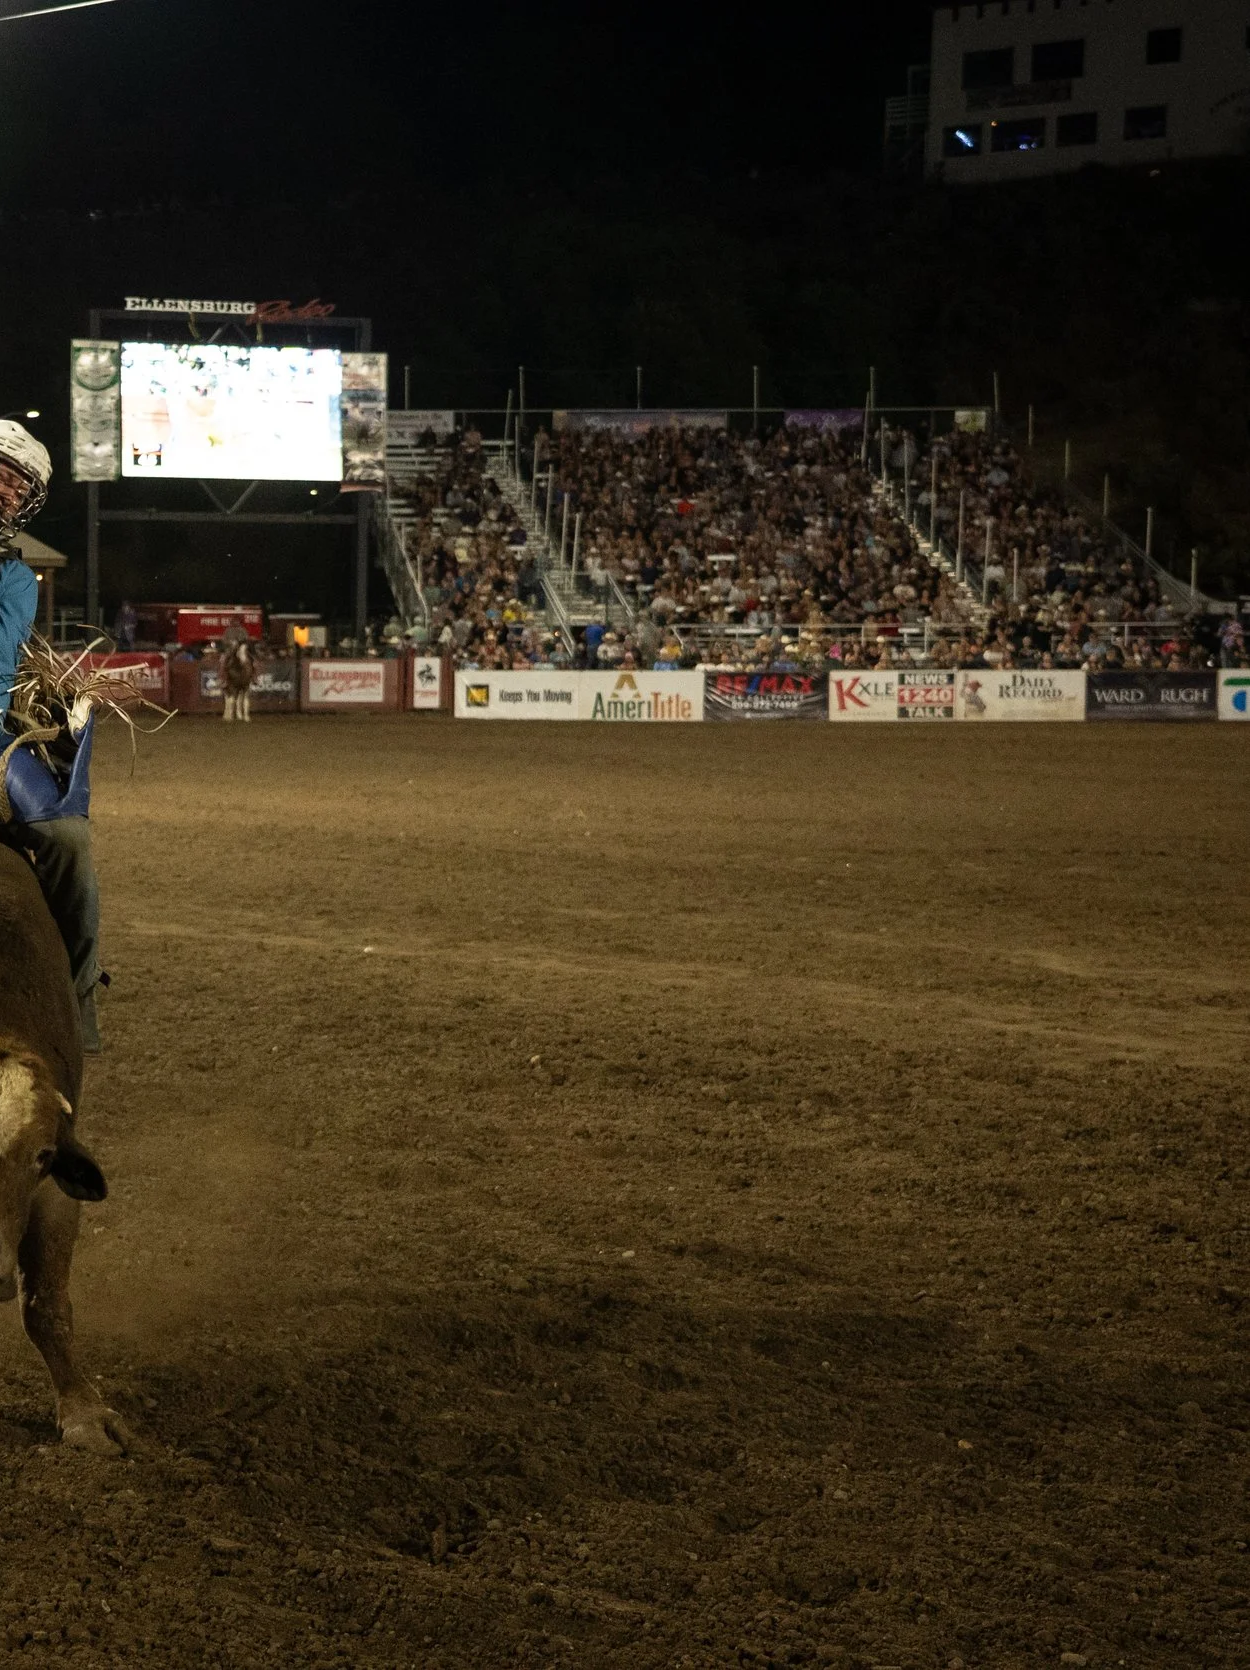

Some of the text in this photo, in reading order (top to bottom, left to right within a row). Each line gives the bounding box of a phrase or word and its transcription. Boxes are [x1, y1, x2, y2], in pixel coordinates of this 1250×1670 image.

[124, 296, 256, 315] ELLENSBURG
[716, 673, 814, 696] RE/MAX
[903, 674, 948, 686] NEWS
[1011, 674, 1054, 687] DAILY
[499, 689, 524, 704] Keeps
[525, 689, 540, 702] You
[543, 690, 572, 705] Moving
[832, 676, 894, 711] KXLE
[899, 688, 954, 704] 1240
[998, 684, 1063, 699] RECORD
[1094, 687, 1211, 704] WARD RUGH
[591, 691, 692, 720] AmeriTitle
[907, 707, 945, 719] TALK
